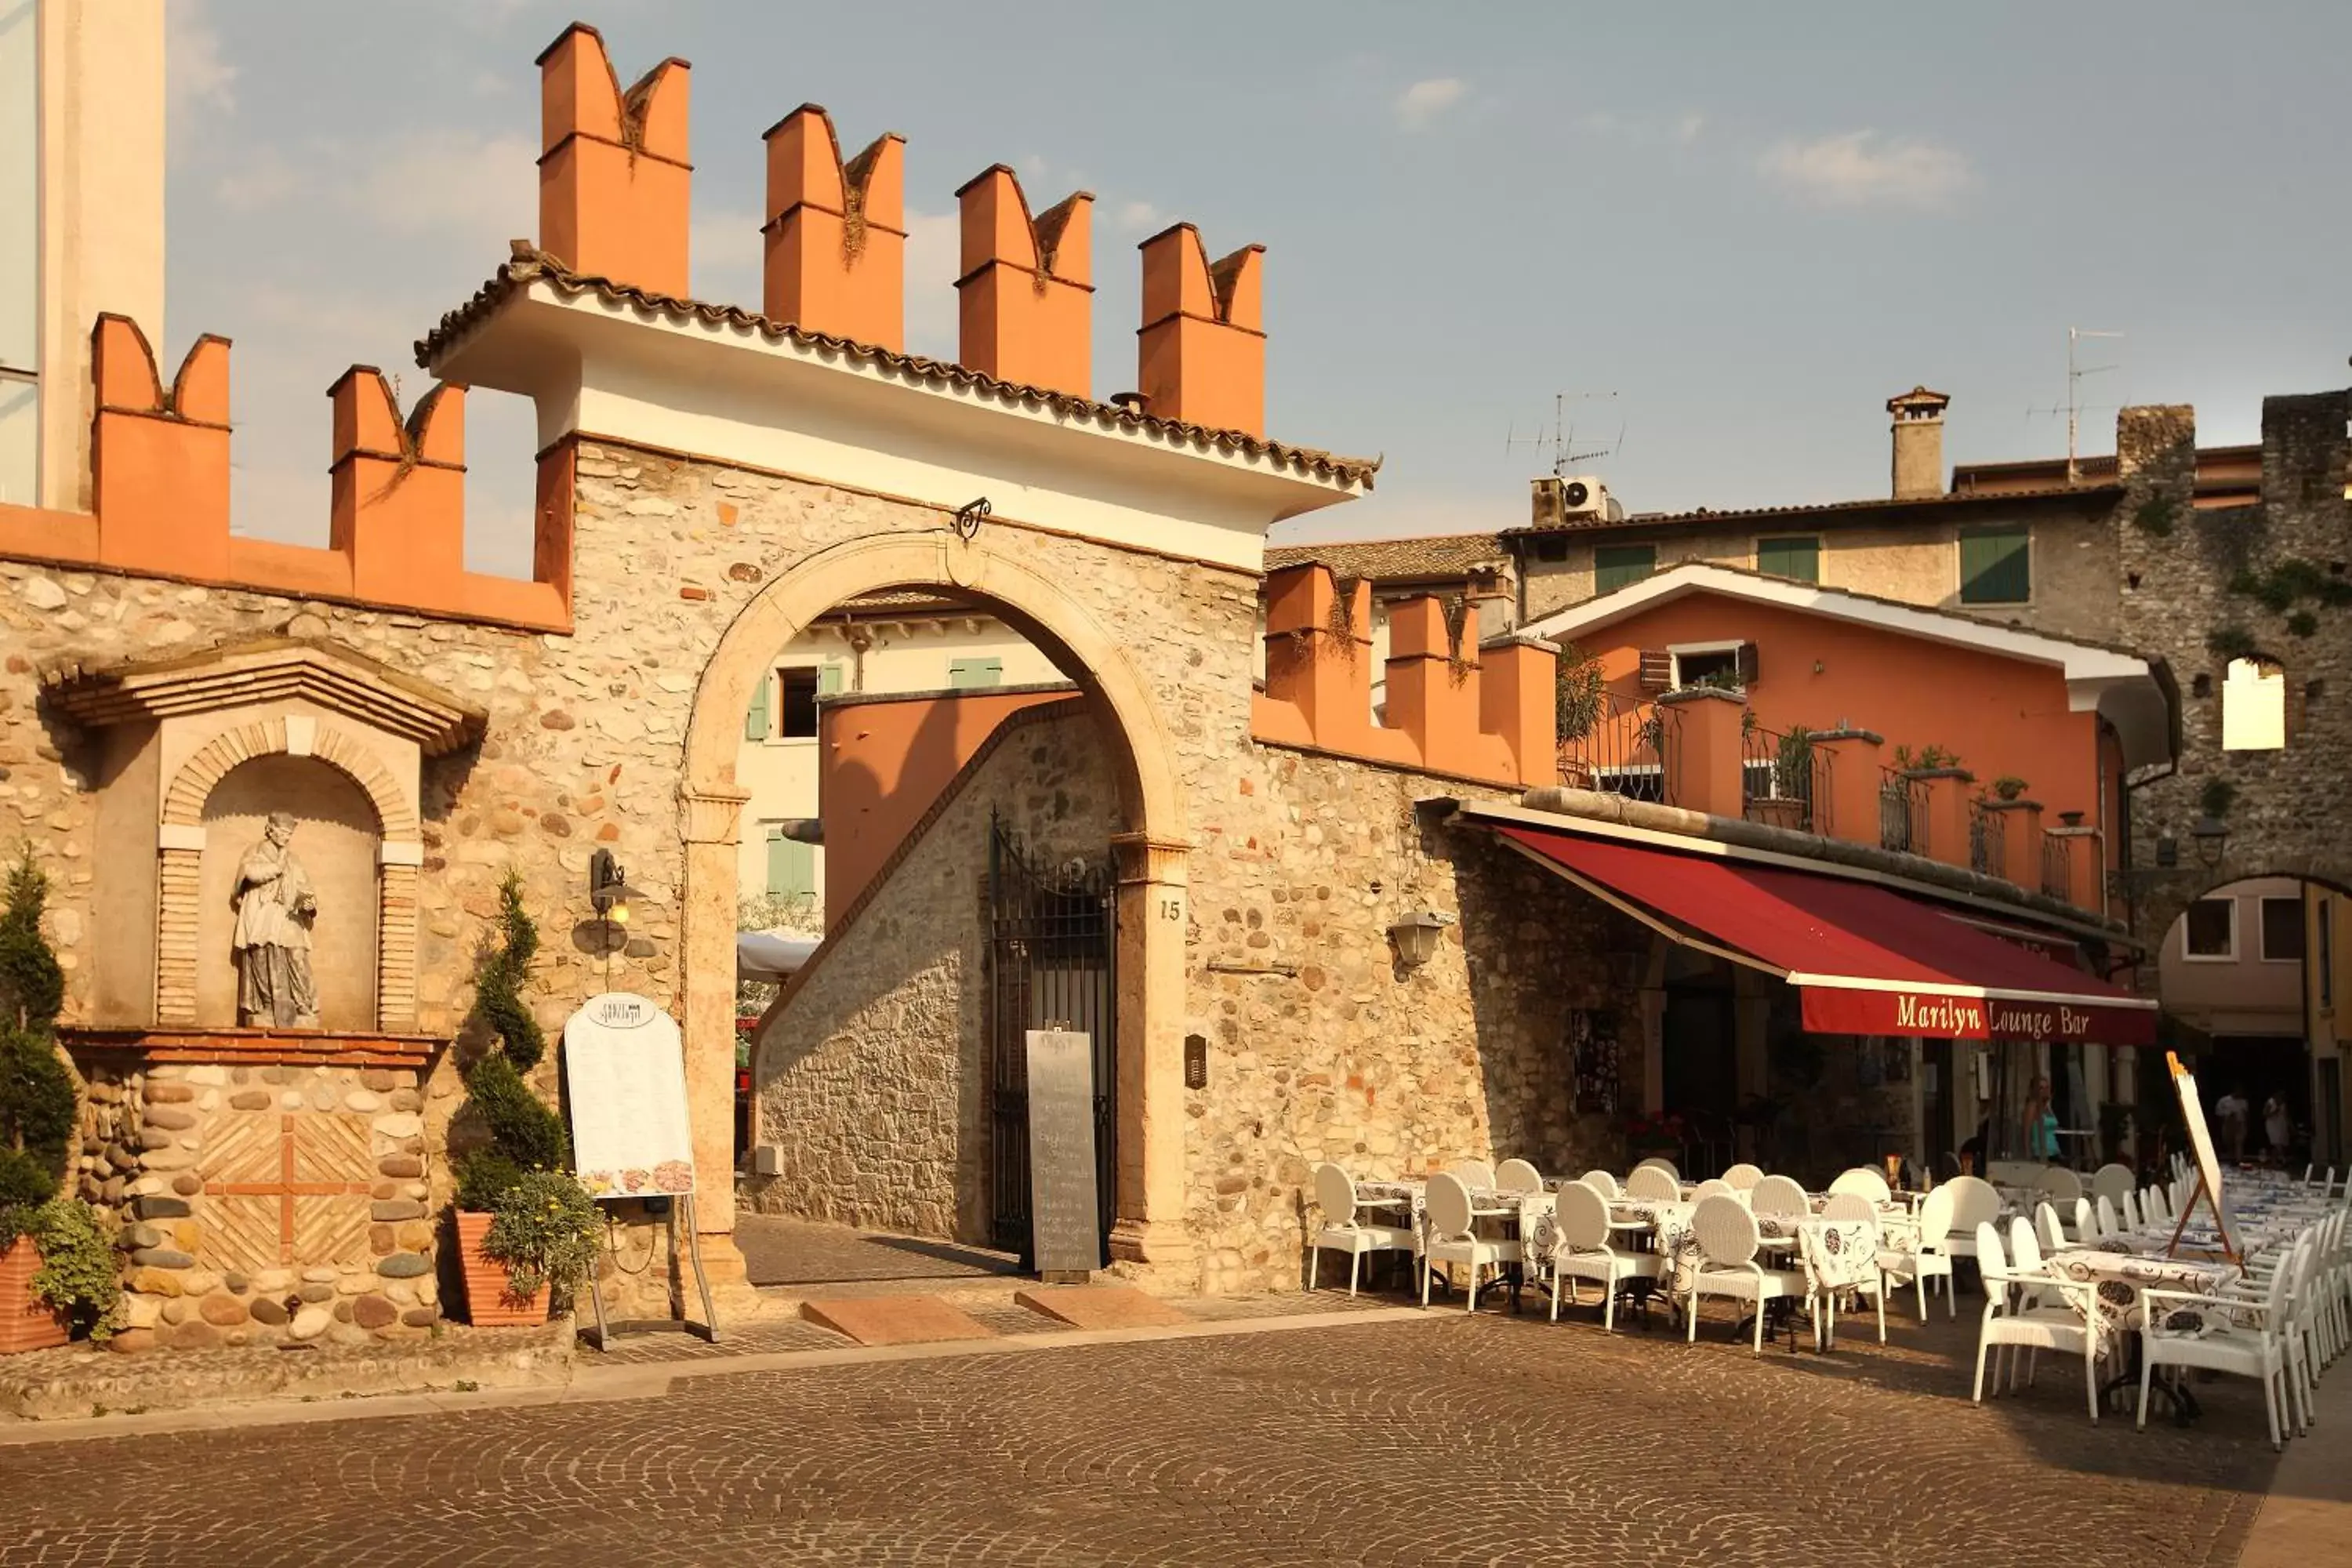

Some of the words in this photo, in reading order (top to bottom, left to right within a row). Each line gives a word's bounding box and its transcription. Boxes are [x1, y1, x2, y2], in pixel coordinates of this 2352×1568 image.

[1161, 901, 1180, 920] 15
[1896, 994, 1981, 1036] Marilyn
[1988, 1001, 2052, 1039] Lounge
[2060, 1007, 2089, 1035] Bar
